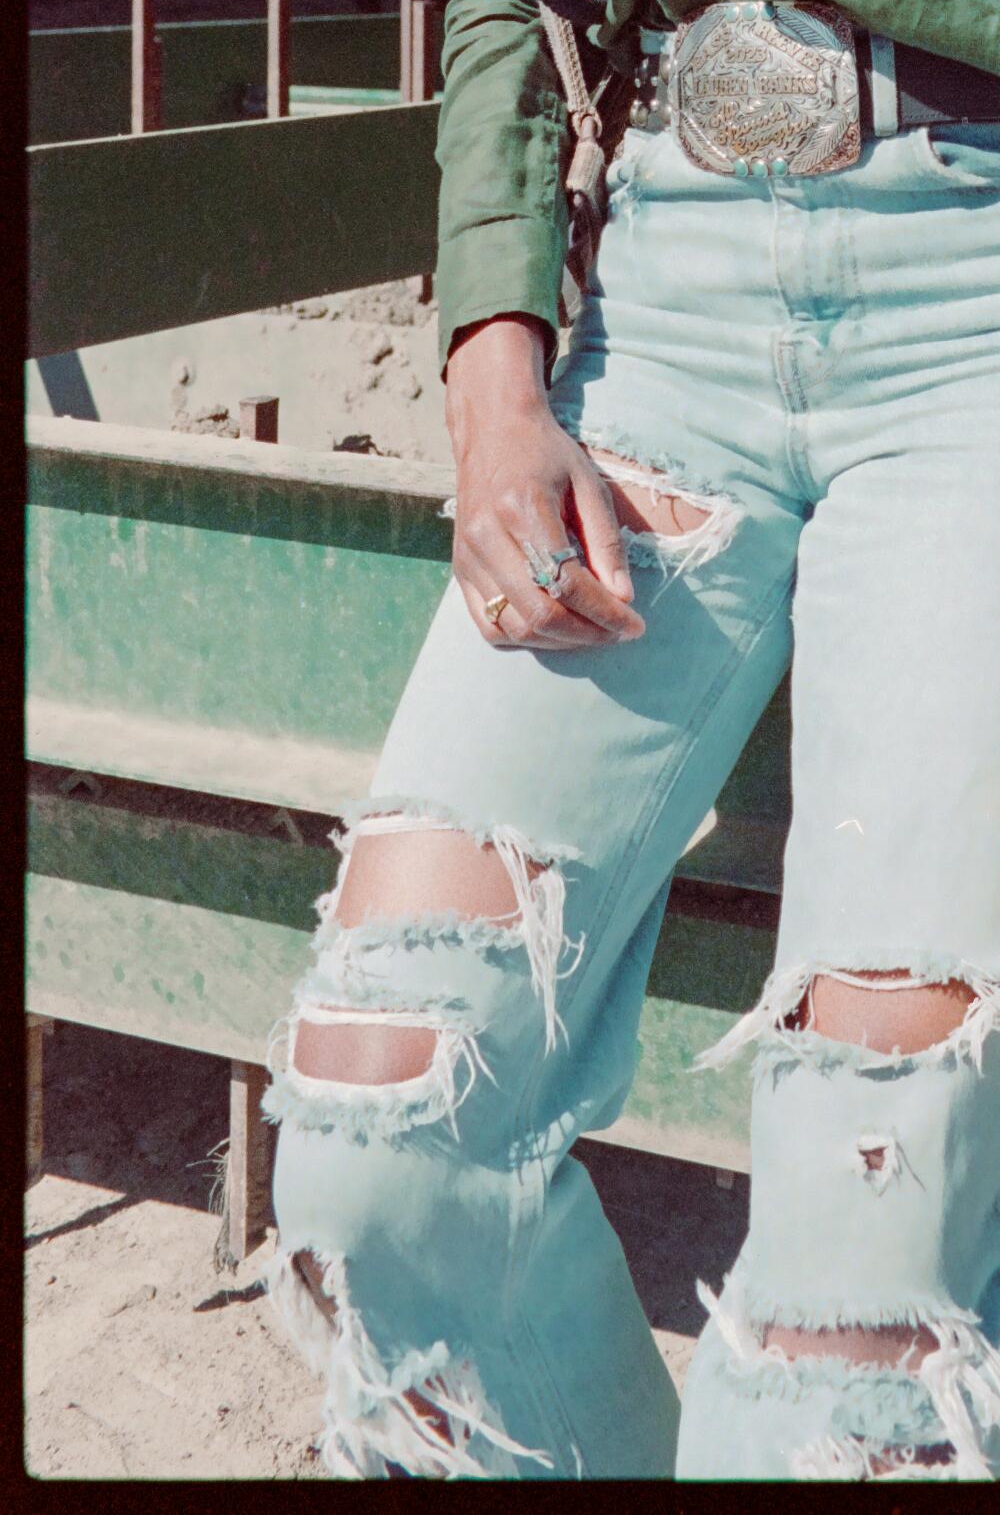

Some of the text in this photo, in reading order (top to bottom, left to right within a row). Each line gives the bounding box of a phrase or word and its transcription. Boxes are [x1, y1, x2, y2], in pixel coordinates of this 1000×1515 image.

[724, 47, 768, 64] 2023
[754, 22, 824, 72] REEVES
[753, 75, 819, 95] BANKS
